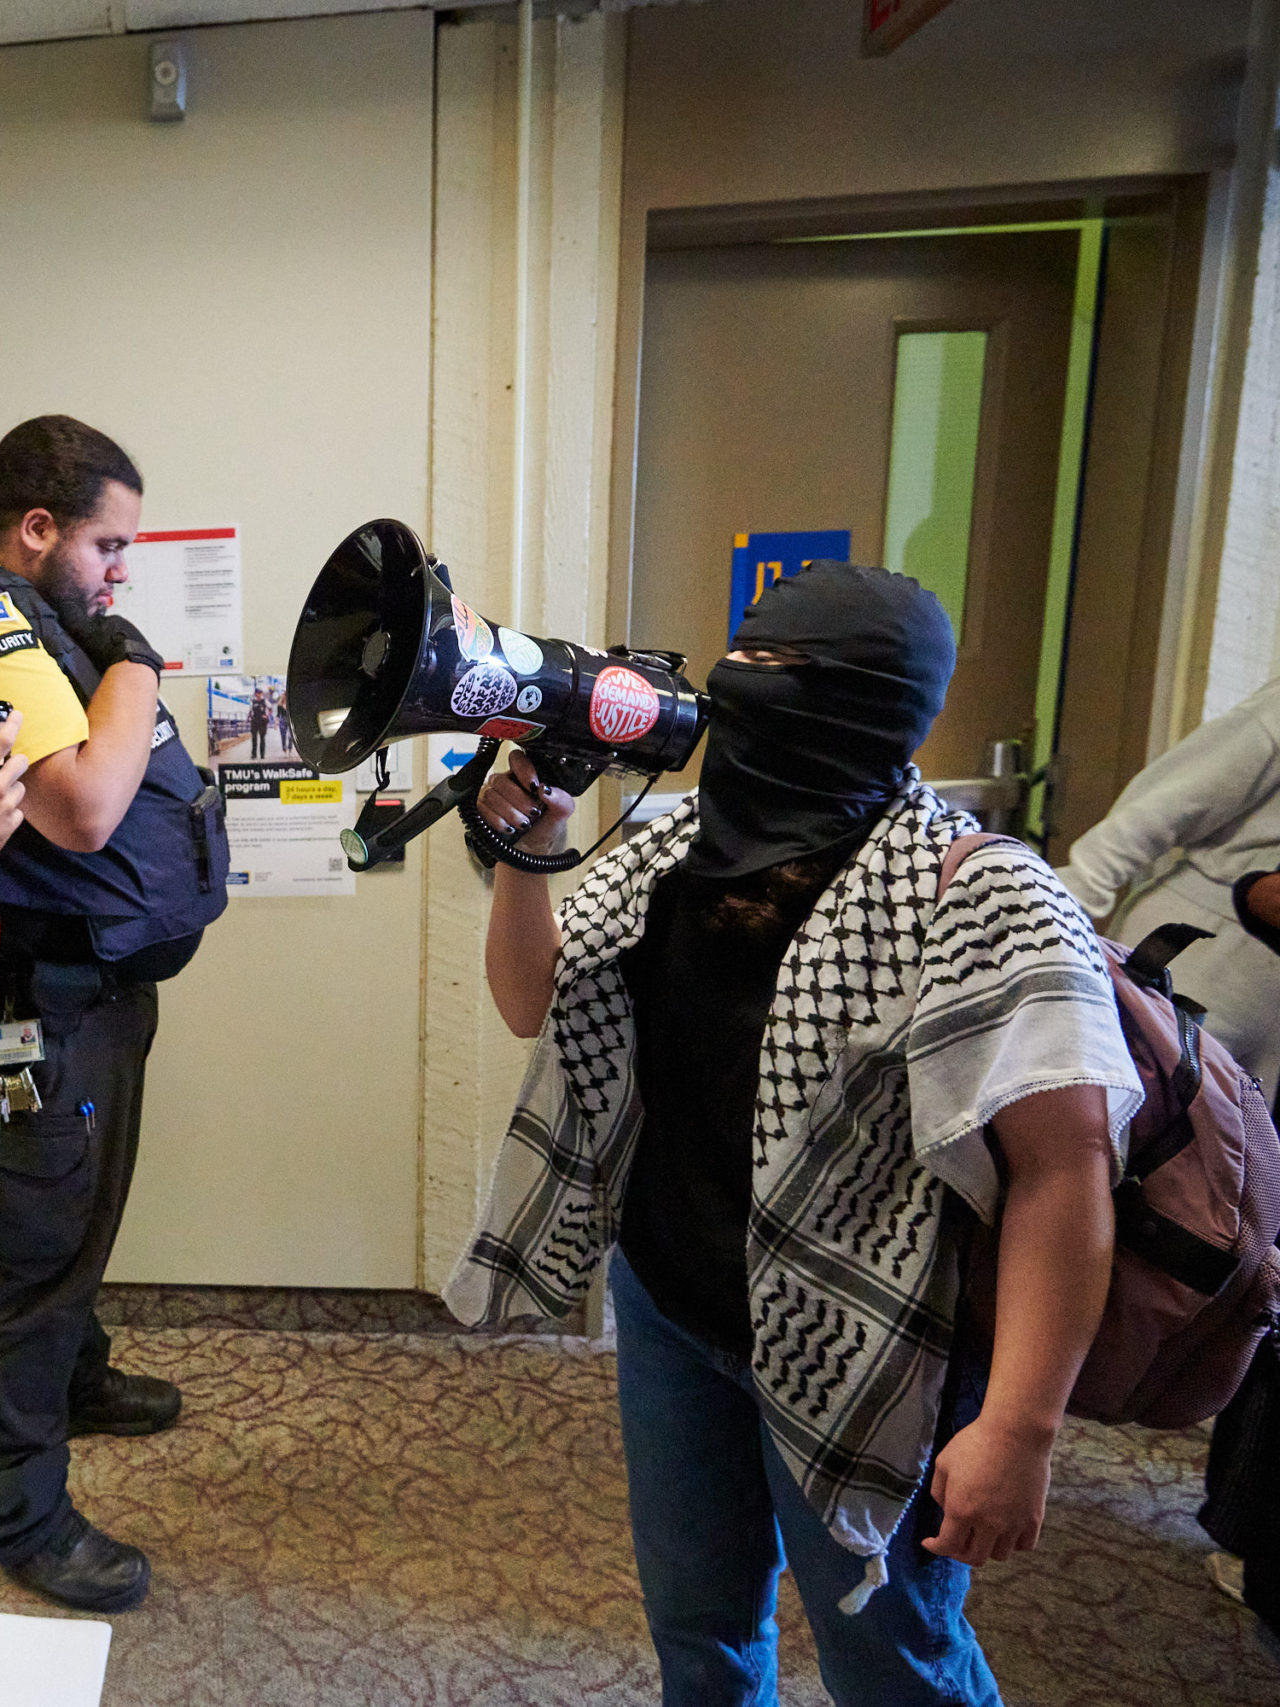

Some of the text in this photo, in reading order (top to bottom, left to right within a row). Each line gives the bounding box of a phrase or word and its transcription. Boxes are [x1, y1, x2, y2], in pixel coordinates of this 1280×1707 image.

[611, 672, 642, 691] WE
[599, 683, 653, 710] DEMAND
[596, 701, 649, 737] JUSTICE
[224, 768, 313, 780] TMU's WalkSafe
[225, 782, 270, 794] program
